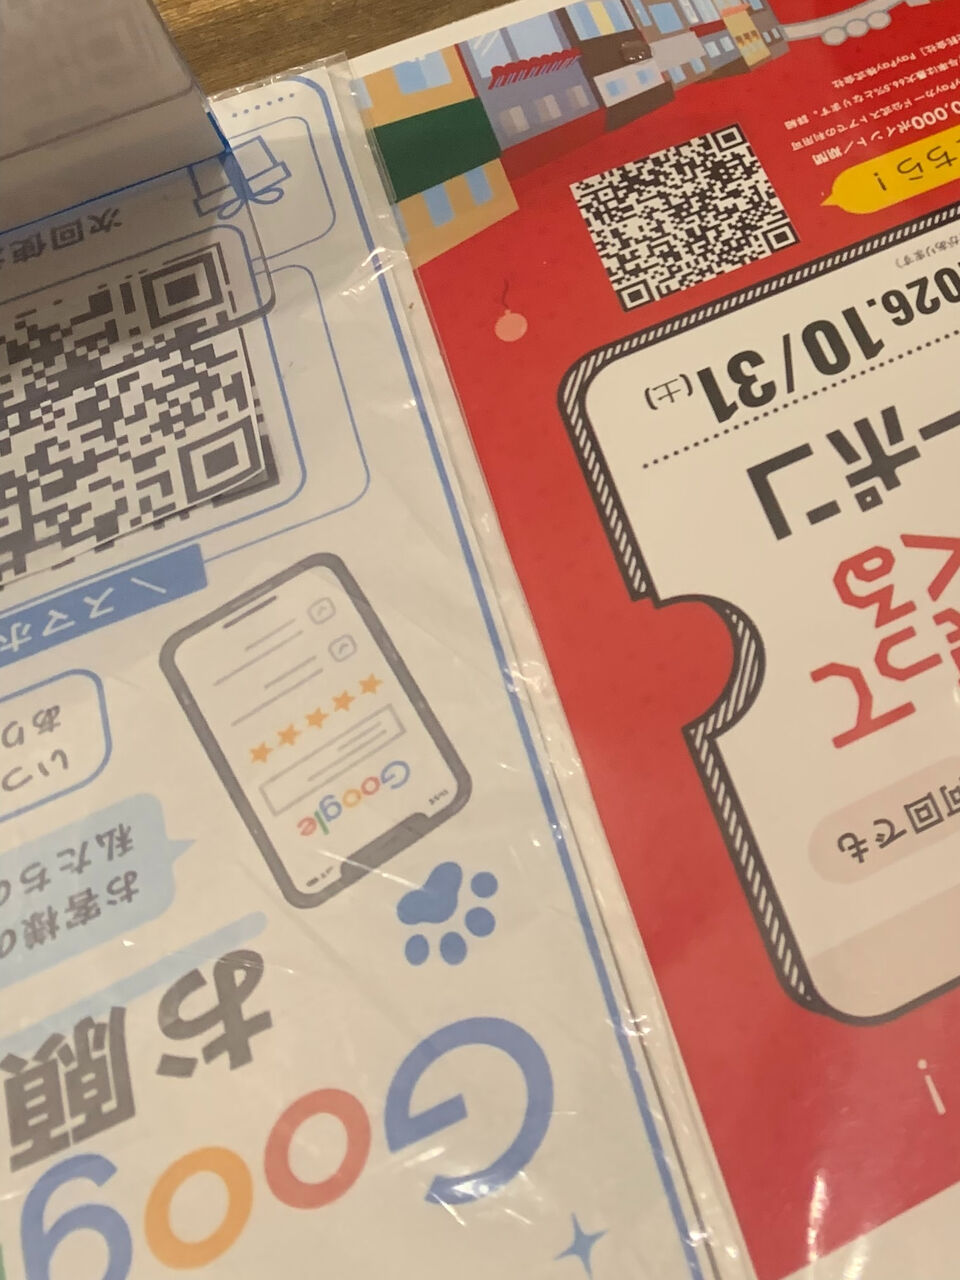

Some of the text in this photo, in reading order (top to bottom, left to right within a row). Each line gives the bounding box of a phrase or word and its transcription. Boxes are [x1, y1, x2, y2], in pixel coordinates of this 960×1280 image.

[0, 208, 122, 271] 次回使
[297, 760, 412, 839] Google
[0, 1016, 555, 1280] Goog
